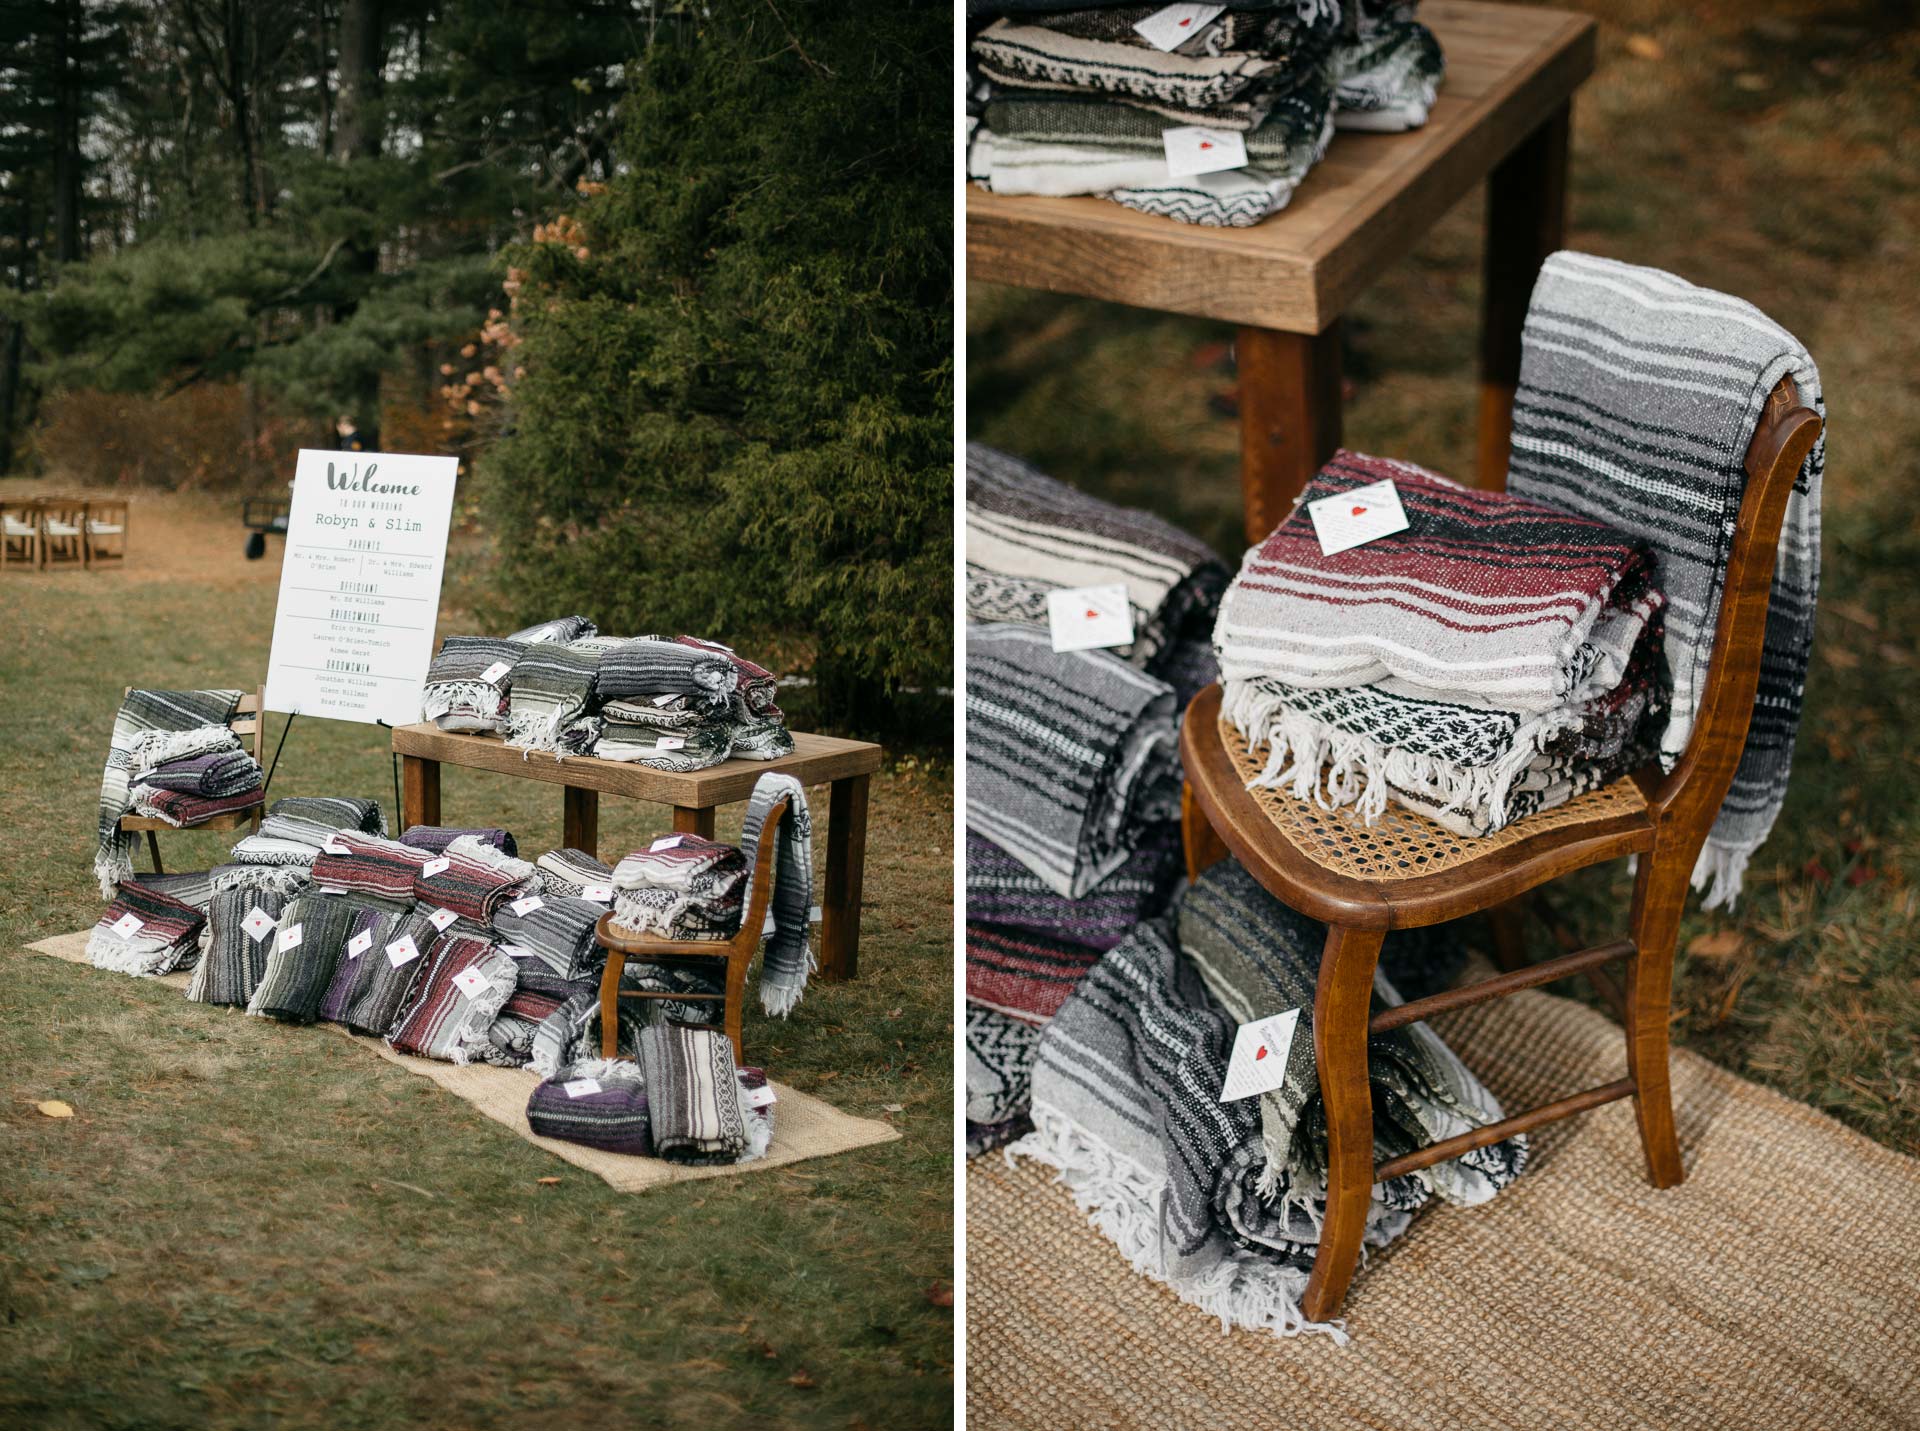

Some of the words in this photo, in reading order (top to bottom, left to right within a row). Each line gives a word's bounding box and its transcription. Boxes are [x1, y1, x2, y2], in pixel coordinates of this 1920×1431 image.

[327, 462, 421, 495] Welcome
[340, 499, 348, 508] TO
[352, 500, 366, 508] OUR
[371, 501, 403, 512] WEDDING
[316, 513, 358, 529] Robyn
[368, 518, 376, 528] &
[385, 518, 422, 532] Slim
[348, 539, 380, 551] PARENTS
[409, 562, 432, 570] Edward
[384, 569, 414, 578] Williams
[340, 580, 378, 594] OFFICIANT
[355, 598, 385, 606] Williams
[330, 608, 380, 623] BRIDESMAIDS
[326, 659, 370, 673] GROOMSMEN
[314, 674, 344, 684] Jonathan
[348, 678, 378, 687] Williams
